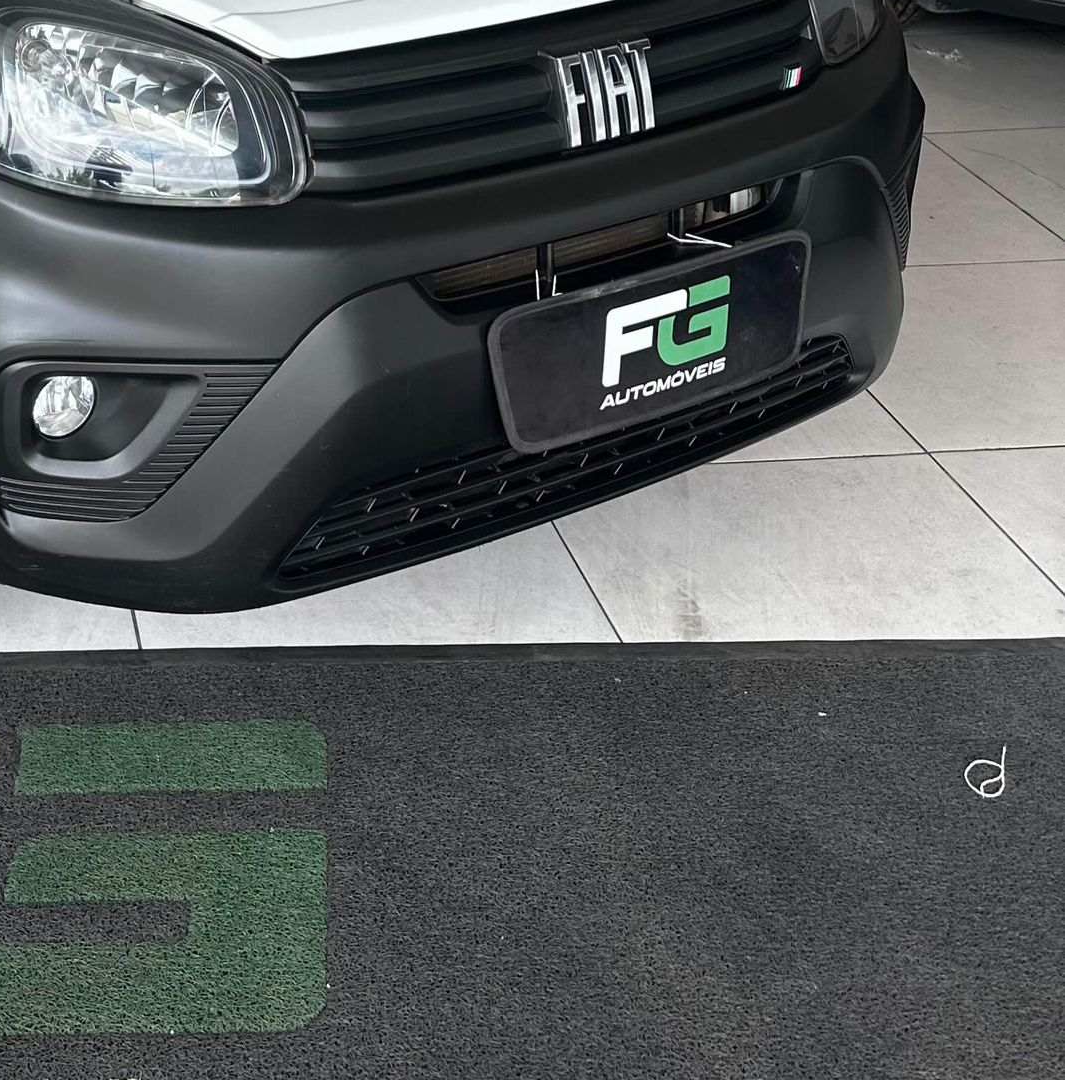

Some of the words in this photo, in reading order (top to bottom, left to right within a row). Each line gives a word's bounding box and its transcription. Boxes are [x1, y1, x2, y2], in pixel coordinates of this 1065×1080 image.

[555, 38, 655, 148] FIAT
[599, 356, 727, 411] AUTOMÓVEIS
[602, 275, 731, 388] FG
